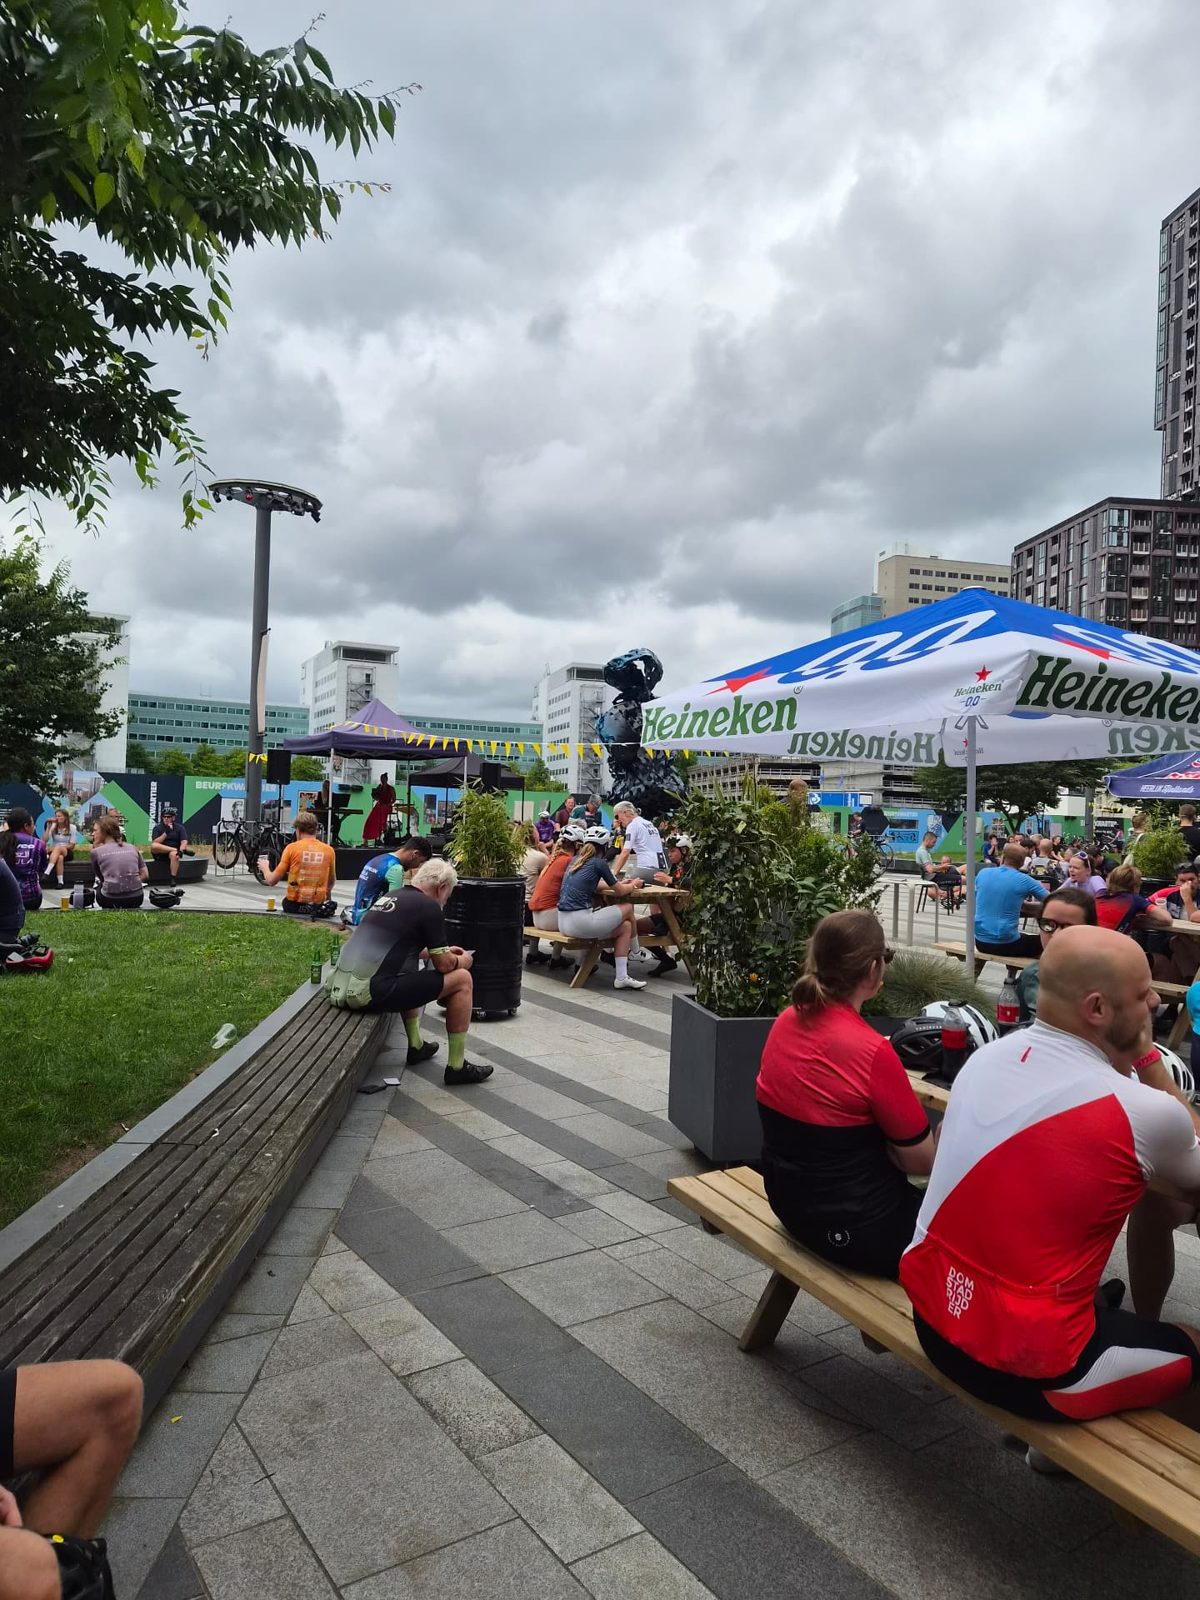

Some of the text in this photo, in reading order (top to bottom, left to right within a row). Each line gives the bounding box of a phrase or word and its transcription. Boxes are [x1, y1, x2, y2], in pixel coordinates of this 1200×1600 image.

[953, 682, 1002, 698] Heineken
[642, 694, 798, 745] Heineken
[946, 1276, 973, 1301] STAD
[949, 1265, 974, 1291] DOM
[946, 1288, 969, 1310] RIJD
[948, 1301, 961, 1320] ER
